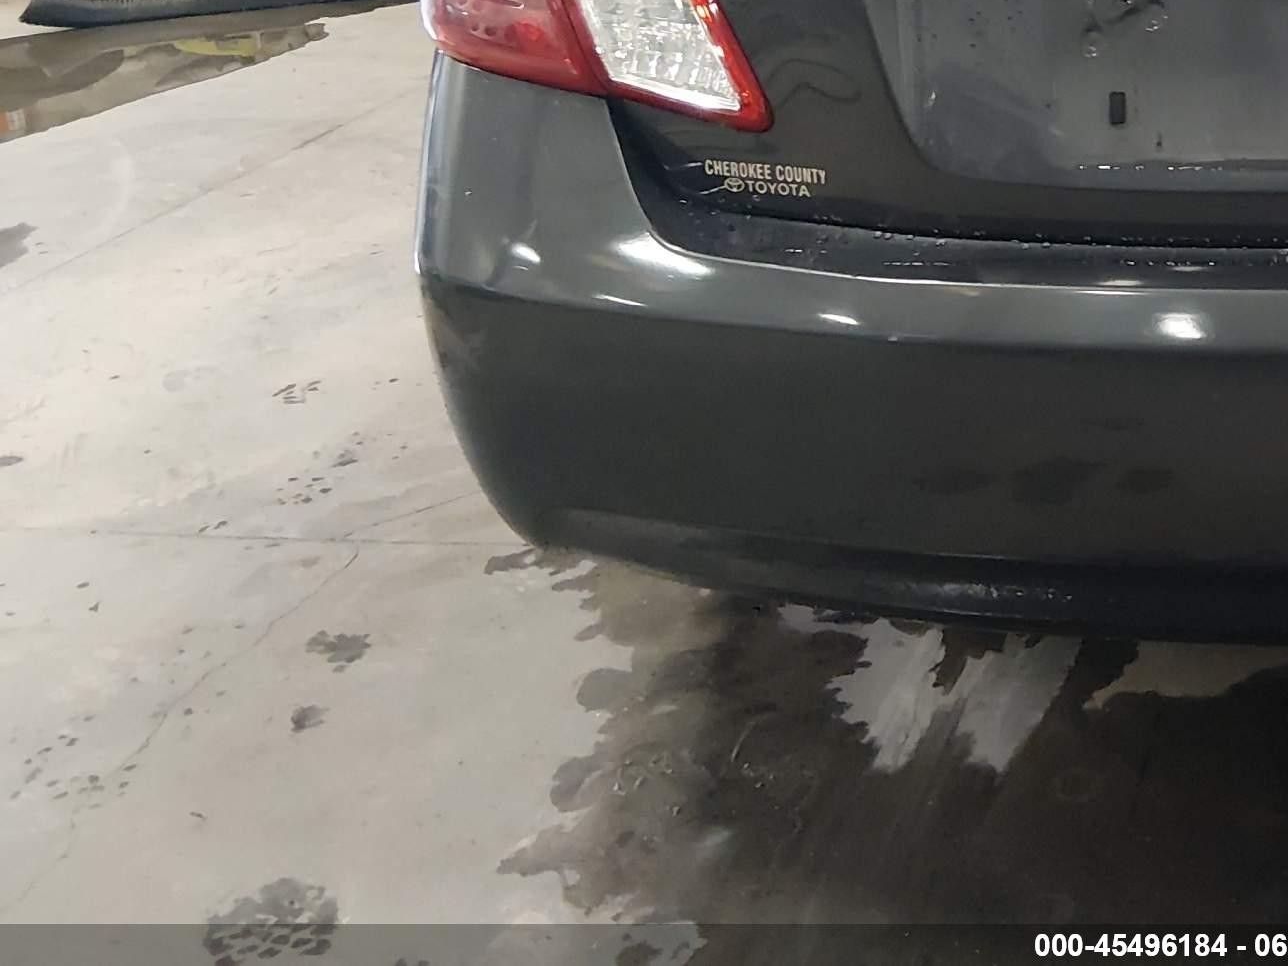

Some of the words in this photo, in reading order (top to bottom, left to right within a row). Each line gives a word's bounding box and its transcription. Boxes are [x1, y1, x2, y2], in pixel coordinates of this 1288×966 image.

[704, 159, 772, 179] CHEROKEE
[775, 165, 826, 184] COUNTY
[745, 180, 812, 197] TOYOTA
